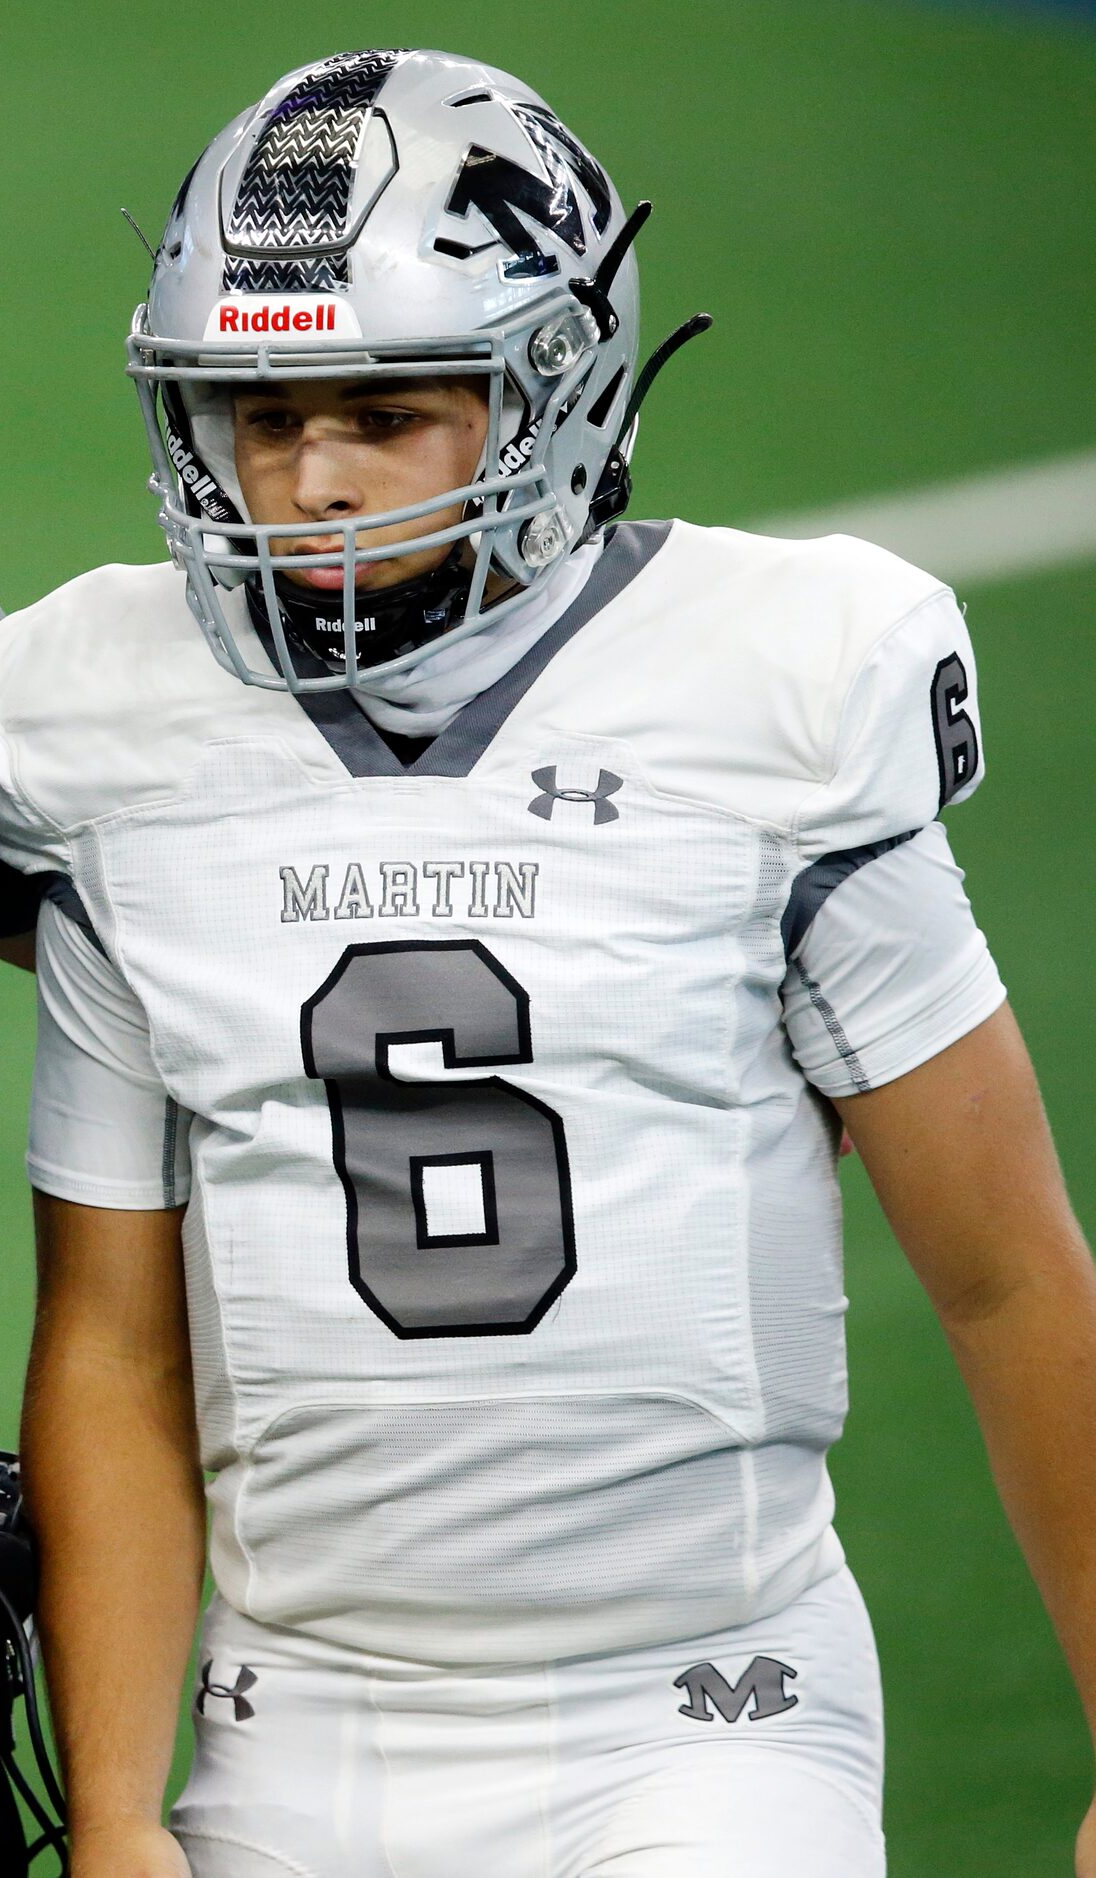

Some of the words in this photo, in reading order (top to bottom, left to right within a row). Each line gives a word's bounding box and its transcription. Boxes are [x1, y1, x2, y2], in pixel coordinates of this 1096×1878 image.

[219, 304, 336, 332] Riddell
[930, 651, 979, 808] 6
[279, 861, 539, 923] MARTIN
[300, 938, 578, 1340] 6
[673, 1656, 799, 1723] M
